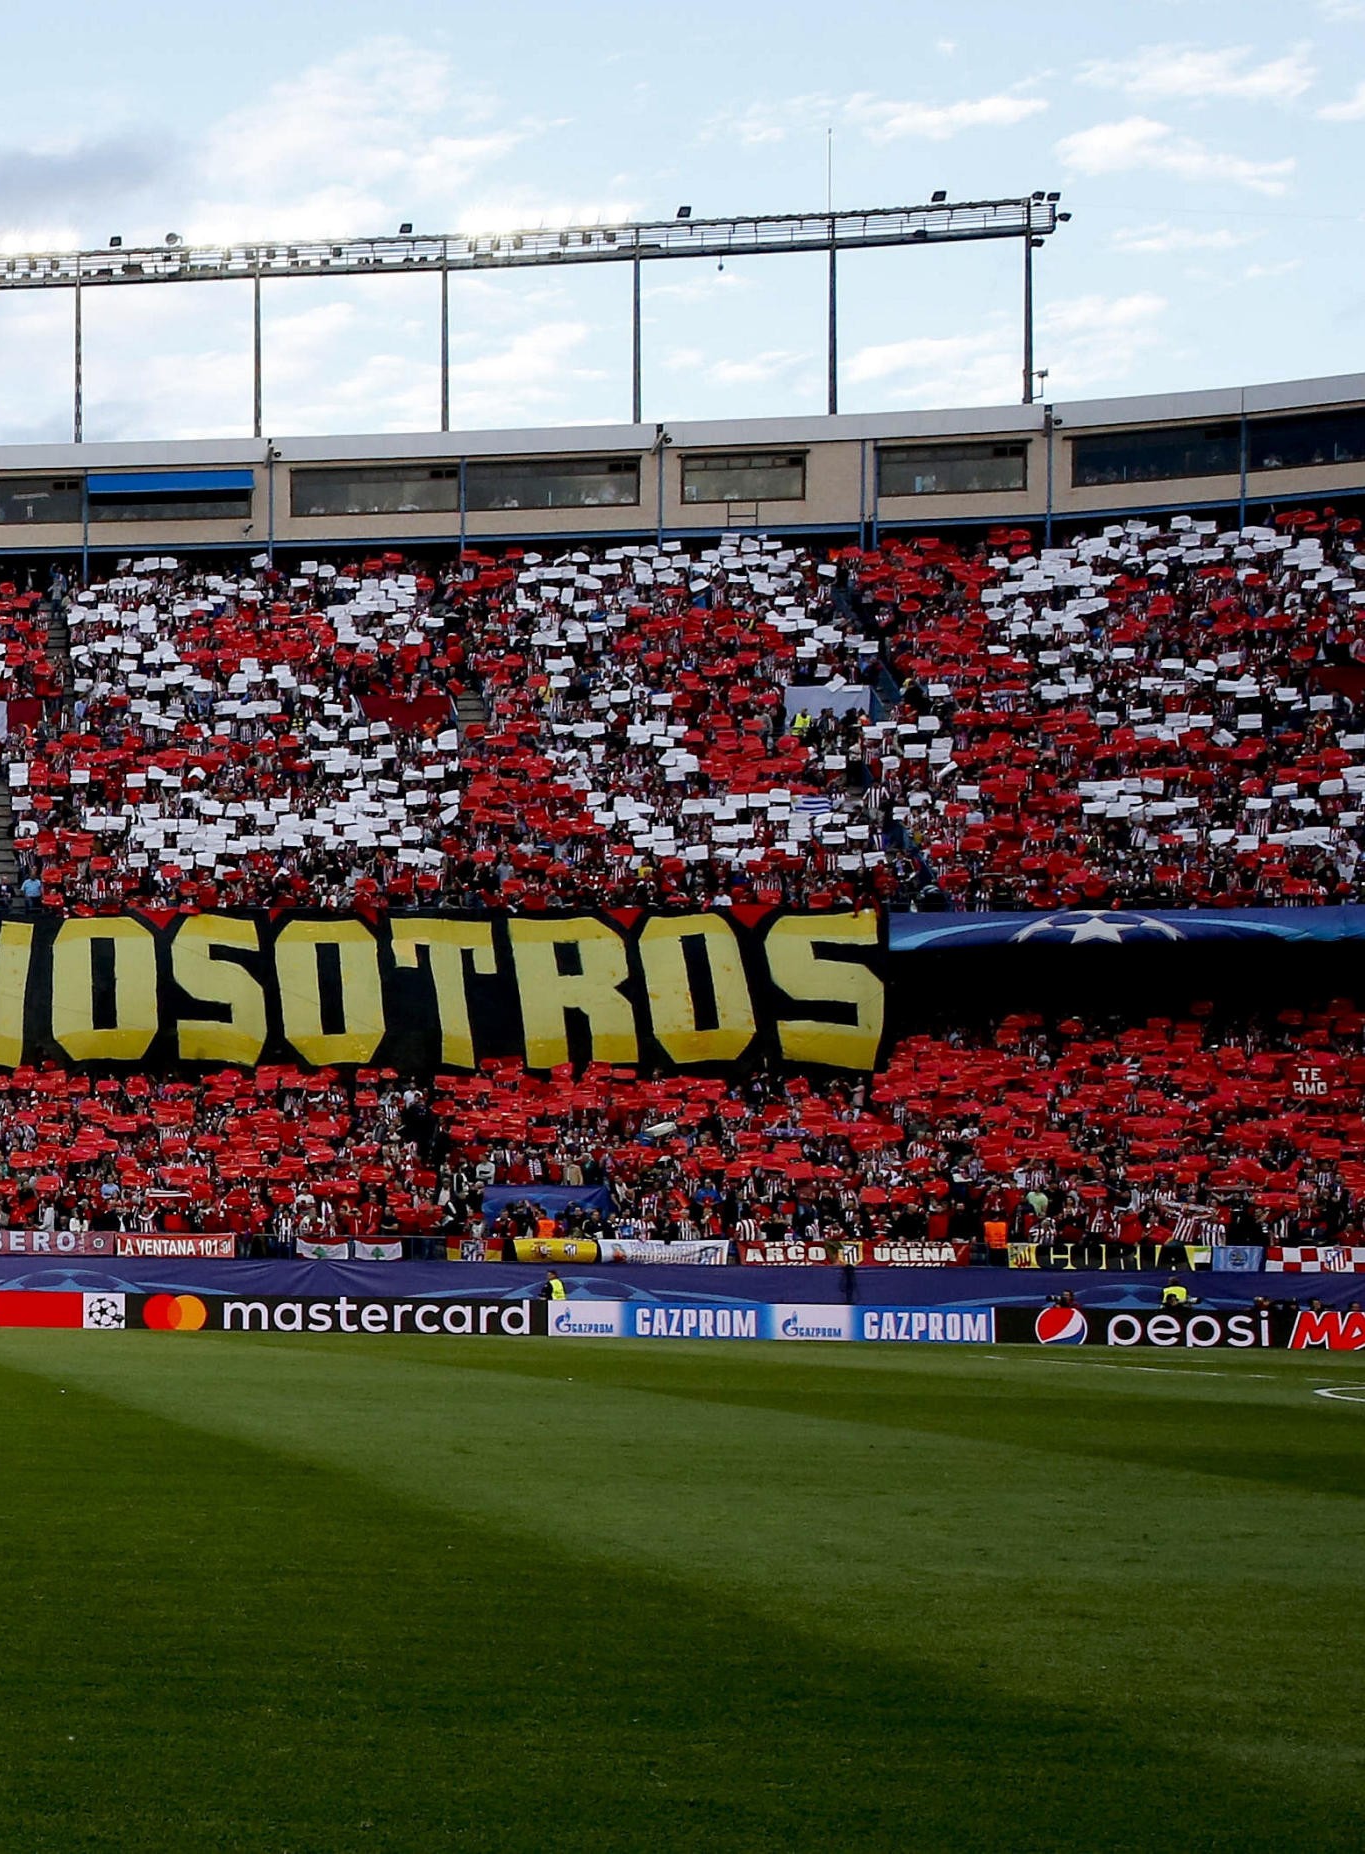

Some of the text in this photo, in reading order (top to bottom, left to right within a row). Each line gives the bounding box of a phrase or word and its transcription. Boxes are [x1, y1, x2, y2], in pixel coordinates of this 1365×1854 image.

[1298, 1068, 1321, 1081] TE
[117, 1238, 218, 1256] LA VENTANA 101
[745, 1246, 826, 1262] ARCO
[873, 1246, 958, 1262] UGENA
[223, 1296, 531, 1335] mastercard
[571, 1308, 757, 1338] GAZPROM GAZPROM
[799, 1311, 988, 1342] GAZPROM GAZPROM
[1107, 1310, 1270, 1348] pepsi
